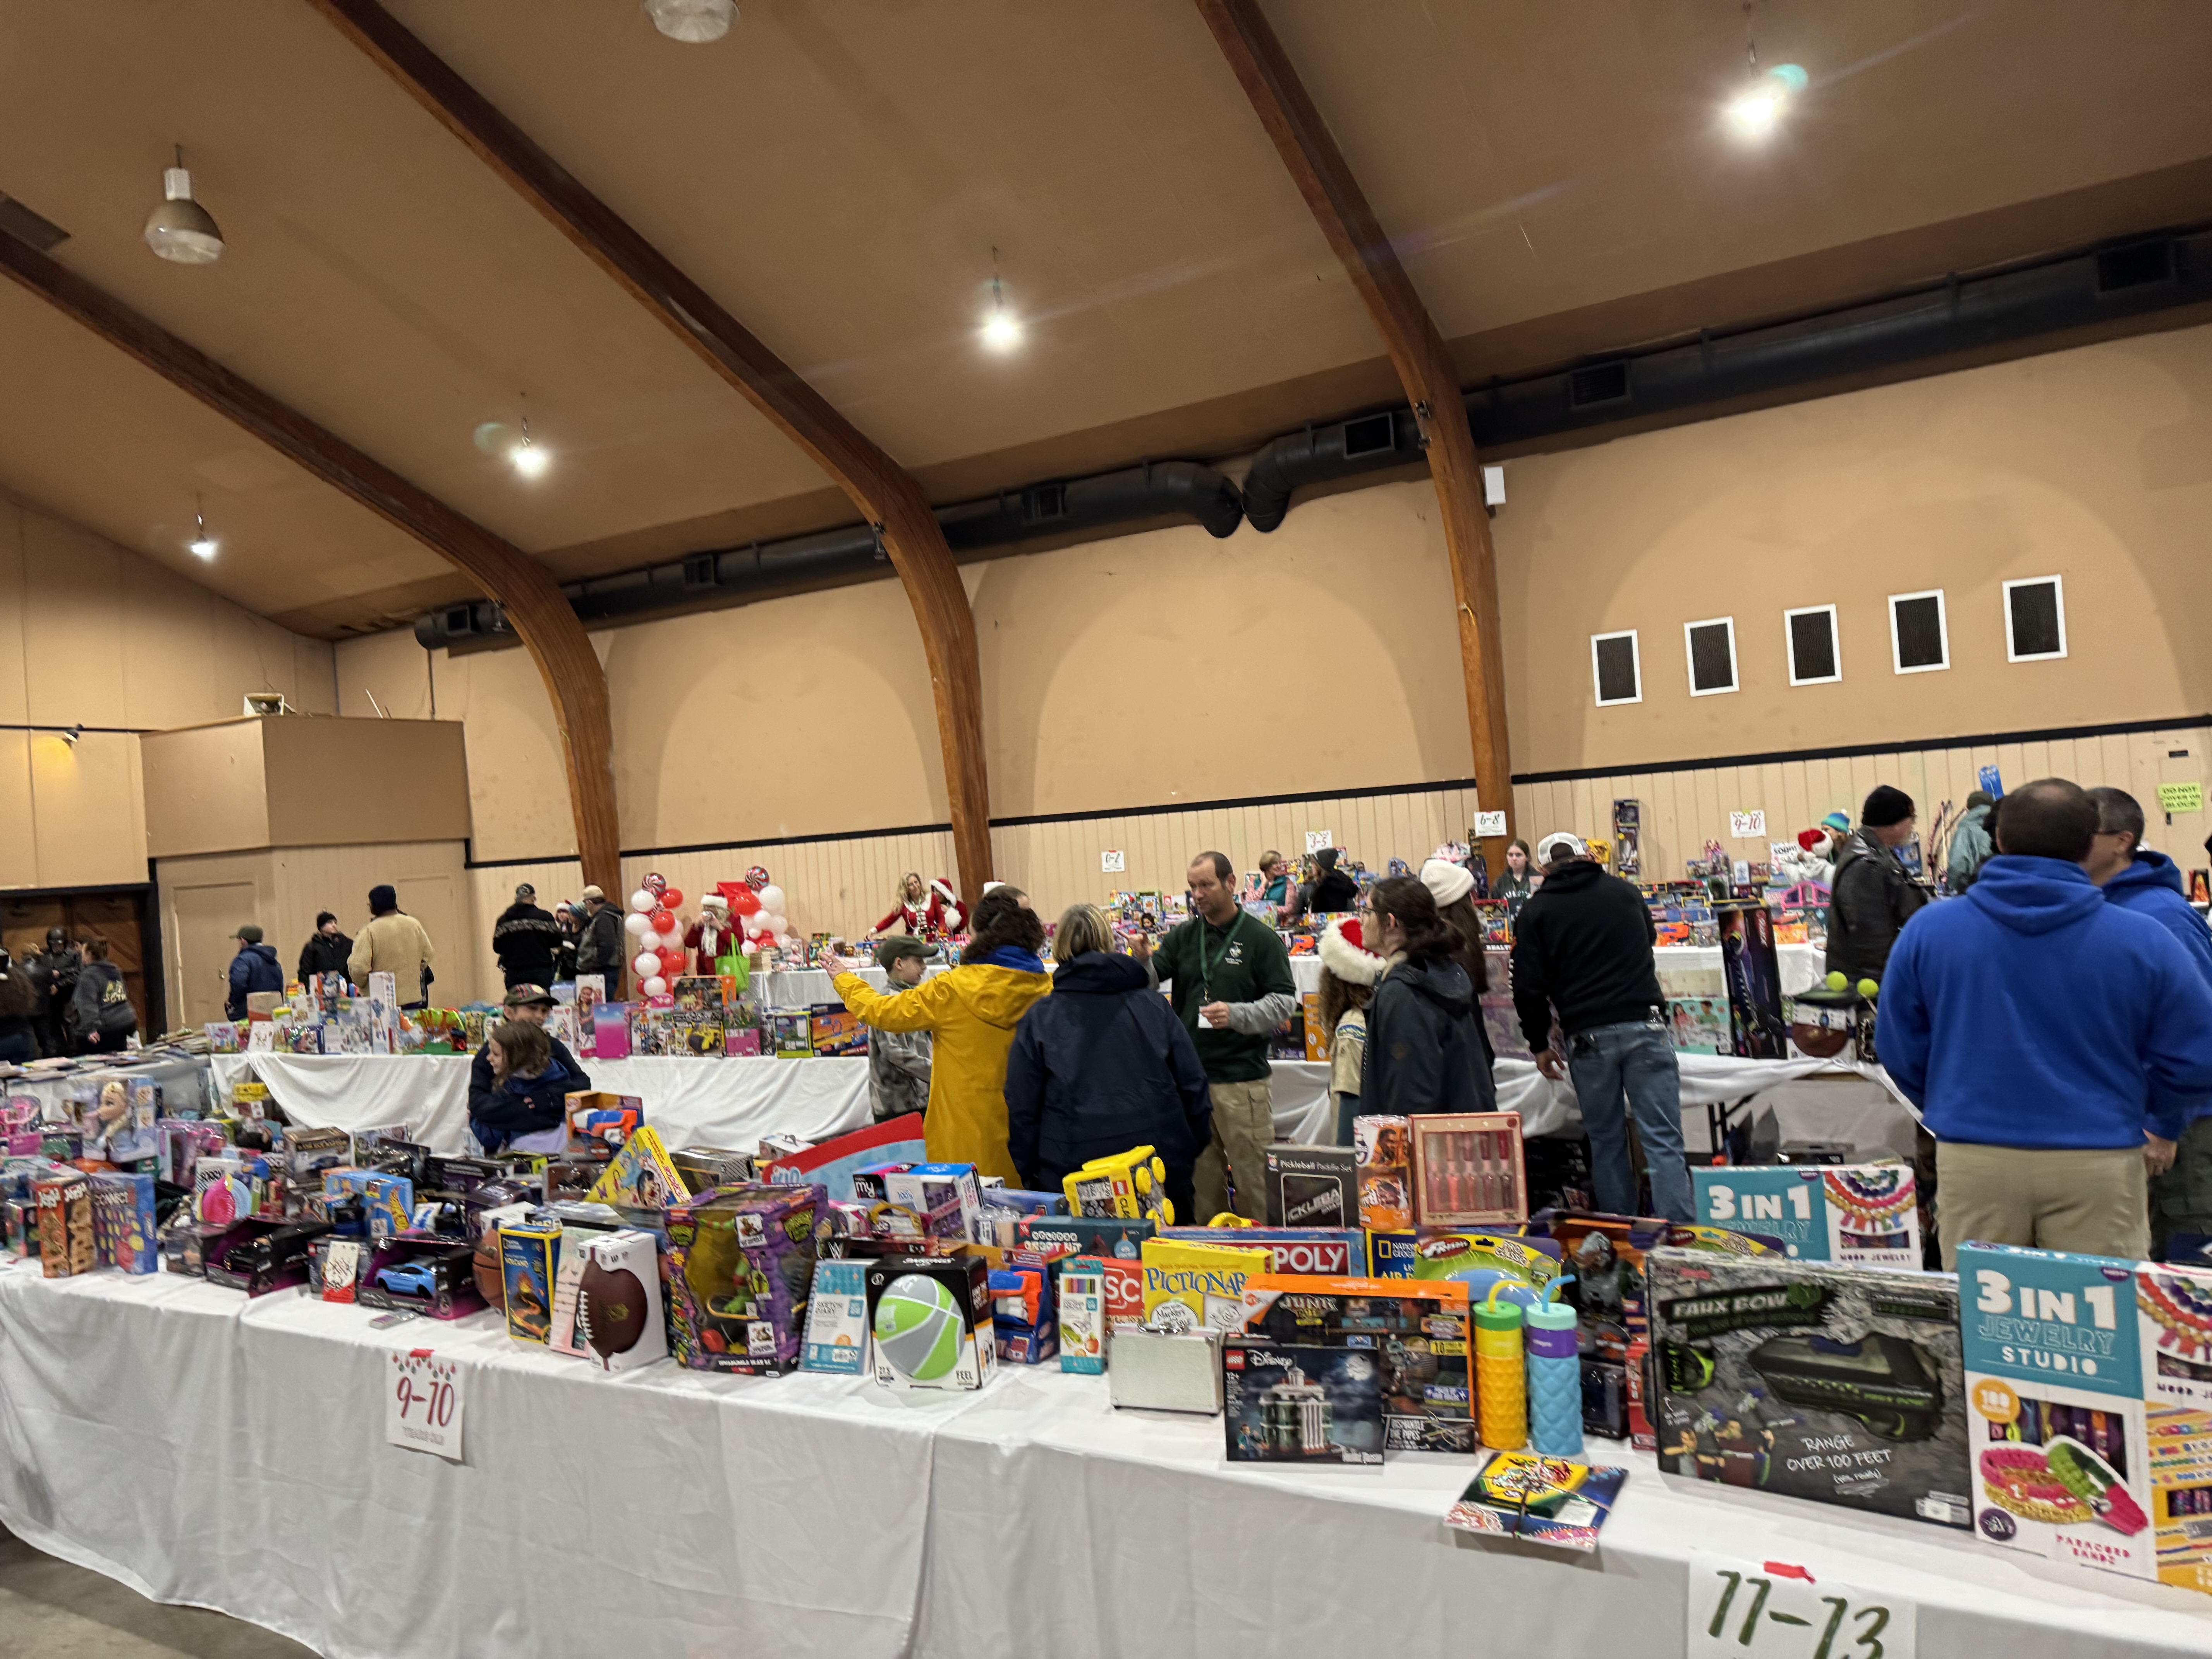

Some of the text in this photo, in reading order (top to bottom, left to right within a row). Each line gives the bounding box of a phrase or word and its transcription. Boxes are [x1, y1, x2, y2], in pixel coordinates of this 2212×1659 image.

[1280, 1160, 1315, 1169] Pickleball
[1709, 1185, 1811, 1220] 3 IN 1
[1274, 1245, 1345, 1272] POLY
[1144, 1266, 1249, 1295] PICTIONAR
[1673, 1293, 1788, 1317] FAUX BOW
[1976, 1269, 2116, 1330] 3 IN 1
[1978, 1315, 2116, 1355] JEWELRY
[1247, 1349, 1293, 1372] Disney
[2001, 1345, 2098, 1376] STUDIO
[397, 1376, 455, 1427] 9-10
[1801, 1434, 1856, 1452] RANGE
[1786, 1449, 1892, 1472] OVER 100 FEET
[2056, 1533, 2131, 1559] PARACORD
[1708, 1570, 1890, 1659] 11-13
